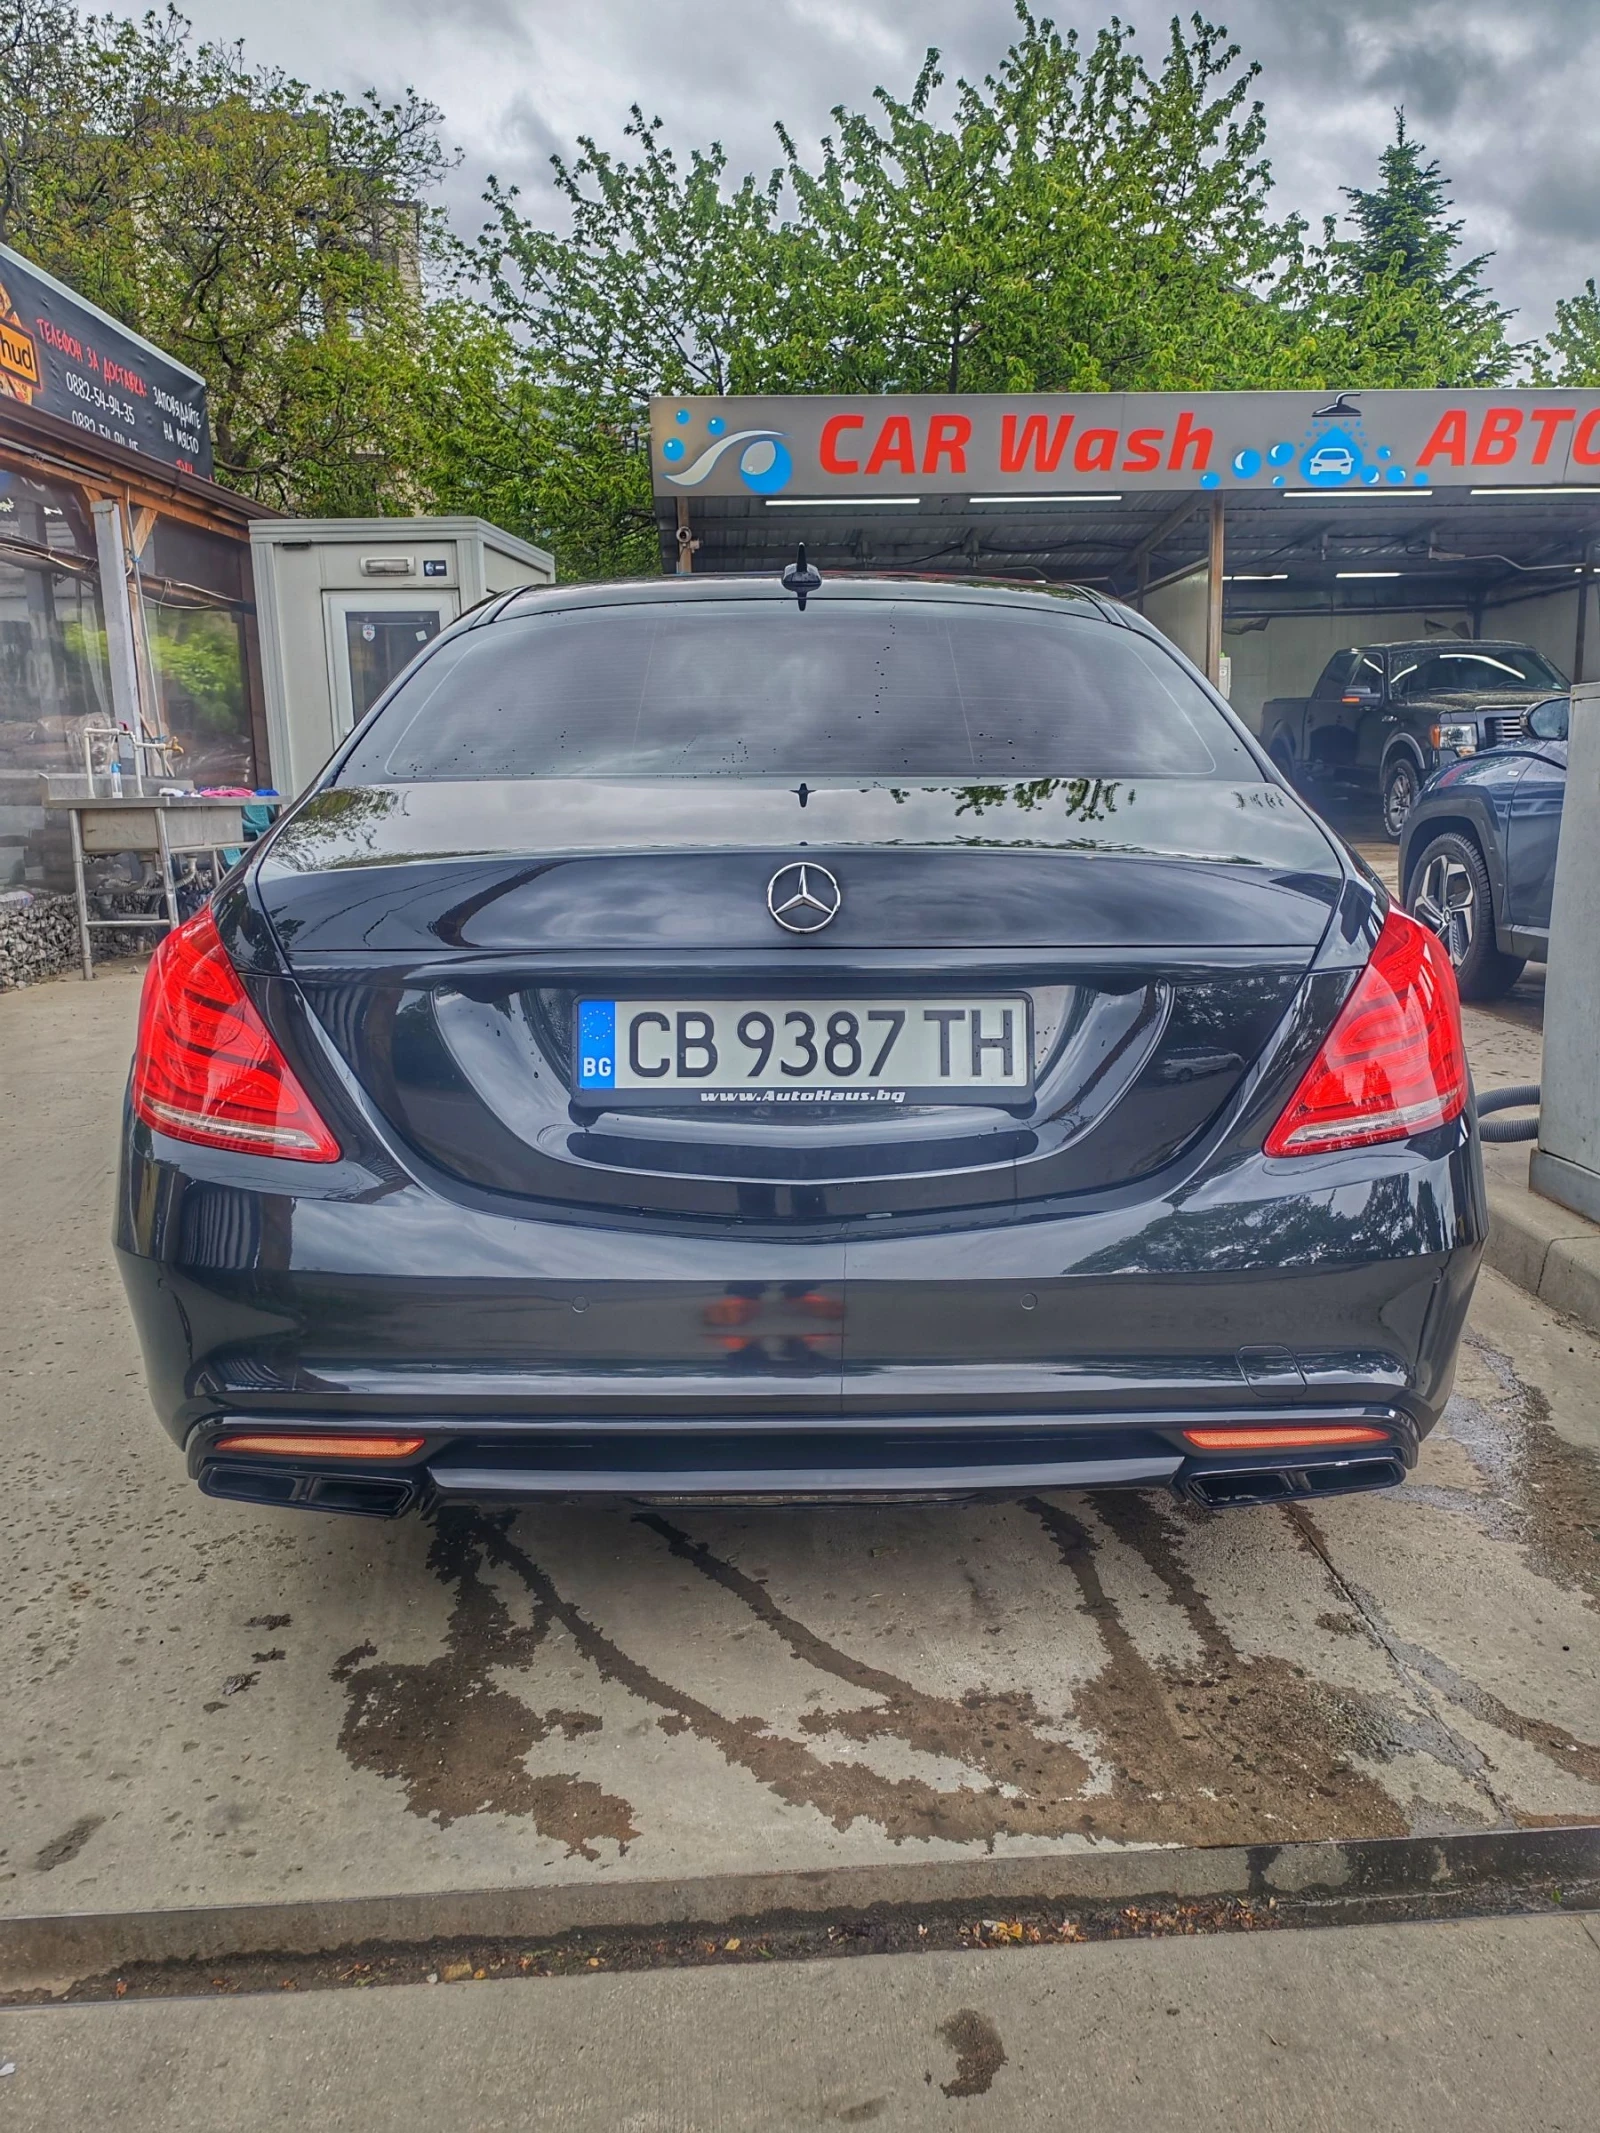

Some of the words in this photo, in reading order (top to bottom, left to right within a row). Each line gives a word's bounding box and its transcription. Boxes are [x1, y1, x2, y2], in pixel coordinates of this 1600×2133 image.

[36, 318, 84, 363] ТЕЛЕФОН
[87, 346, 100, 372] ЗА
[103, 356, 148, 398] ДОСТАВКА:
[65, 371, 136, 426] 0882-54-94-35
[152, 385, 202, 430] ЗАПОВЯДАЙТЕ
[163, 420, 175, 443] НА
[176, 428, 200, 454] МЯСТО
[819, 414, 972, 475] CAR
[1000, 412, 1215, 473] Wash
[583, 1057, 612, 1077] BG
[629, 1010, 719, 1079] CB
[737, 1010, 906, 1078] 9387
[923, 1009, 1014, 1077] TH
[700, 1090, 906, 1103] www.AutoHaus.bg
